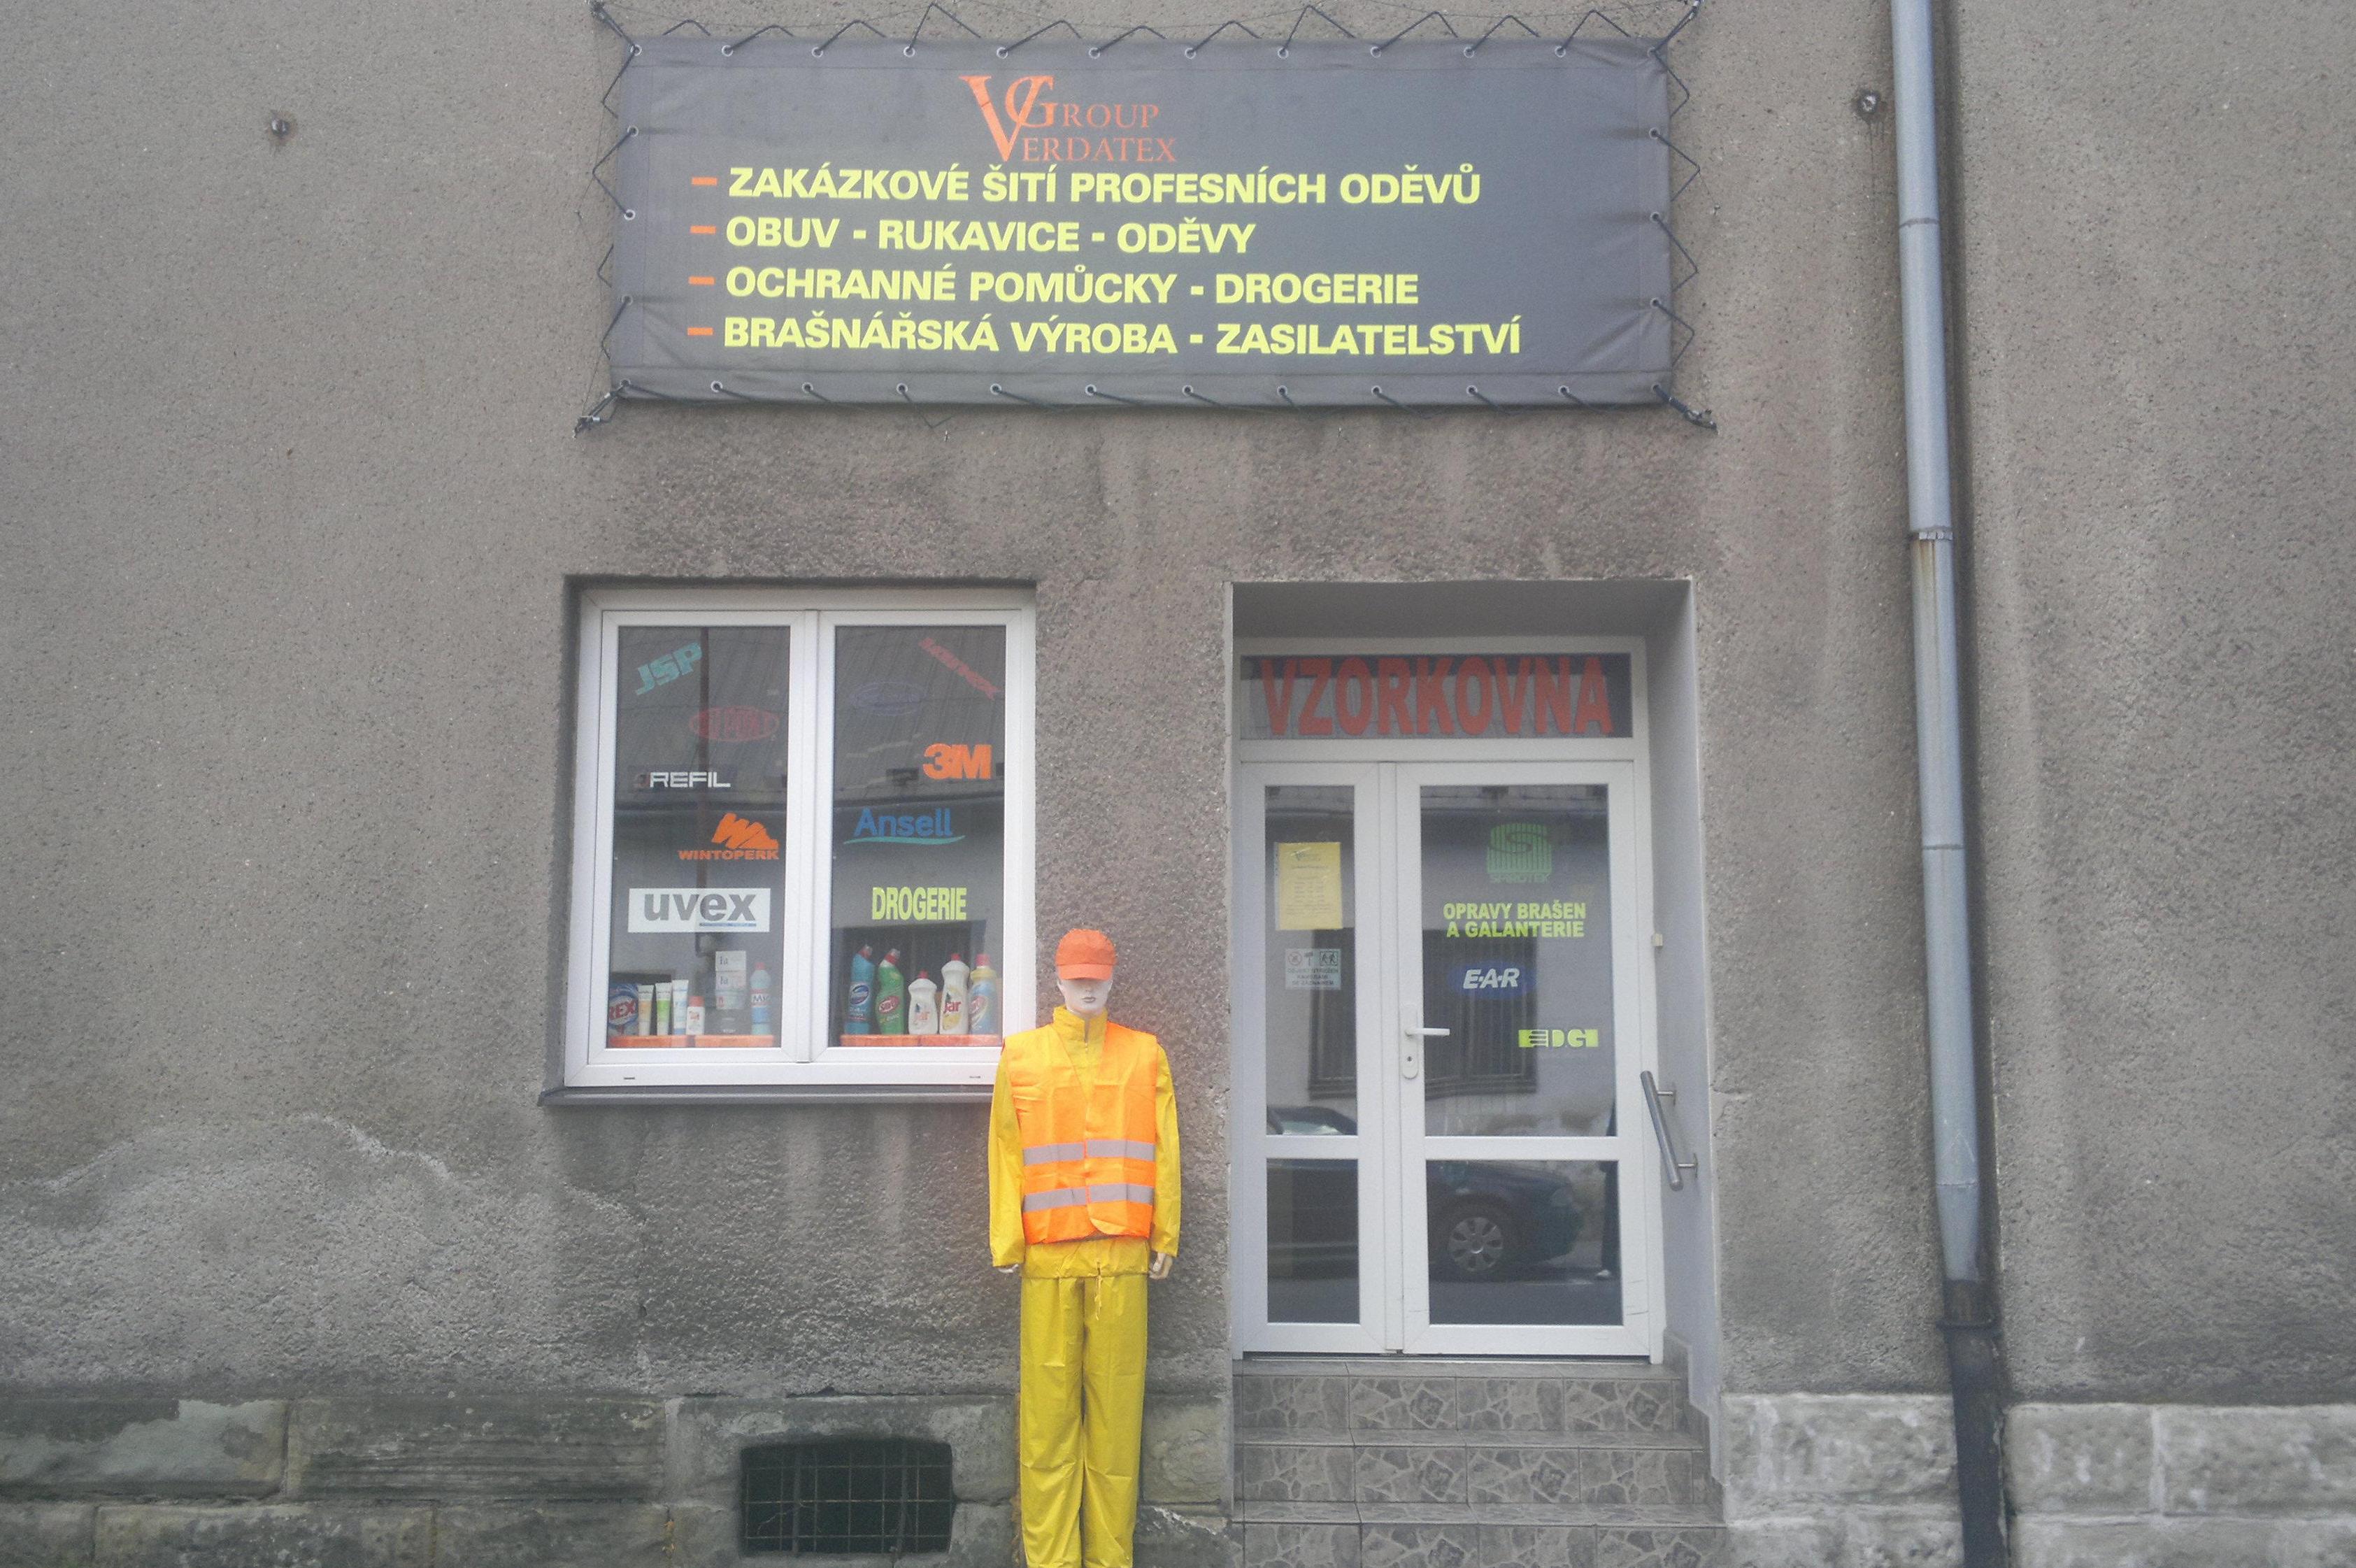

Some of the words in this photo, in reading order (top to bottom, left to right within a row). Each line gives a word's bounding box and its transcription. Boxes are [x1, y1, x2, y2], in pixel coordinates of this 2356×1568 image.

[729, 164, 969, 201] ZAKÁZKOVÉ
[983, 164, 1057, 202] ŠITÍ
[1071, 166, 1326, 204] PROFESNÍCH
[1340, 164, 1481, 204] ODĚVŮ
[726, 215, 840, 248] OBUV
[879, 220, 1080, 252] RUKAVICE
[1118, 218, 1256, 253] ODĚVY
[726, 264, 956, 301] OCHRANNÉ
[970, 264, 1178, 303] POMŮCKY
[1215, 273, 1419, 304] DROGERIE
[724, 311, 999, 352] BRAŠNÁŘSKÁ
[1011, 315, 1178, 353] VÝROBA
[1217, 316, 1521, 355] ZASILATELSTVÍ
[636, 641, 703, 695] JSP
[1262, 657, 1613, 736] VZORKOVNA
[650, 771, 731, 788] REFIL
[922, 742, 992, 780] 3M
[852, 806, 954, 837] Ansell
[644, 893, 757, 922] uvex
[872, 887, 967, 920] DROGERIE
[1443, 903, 1513, 920] OPRAVY
[1518, 899, 1586, 920] BRAŠEN
[1446, 921, 1460, 938] A
[1465, 921, 1585, 938] GALANTERIE
